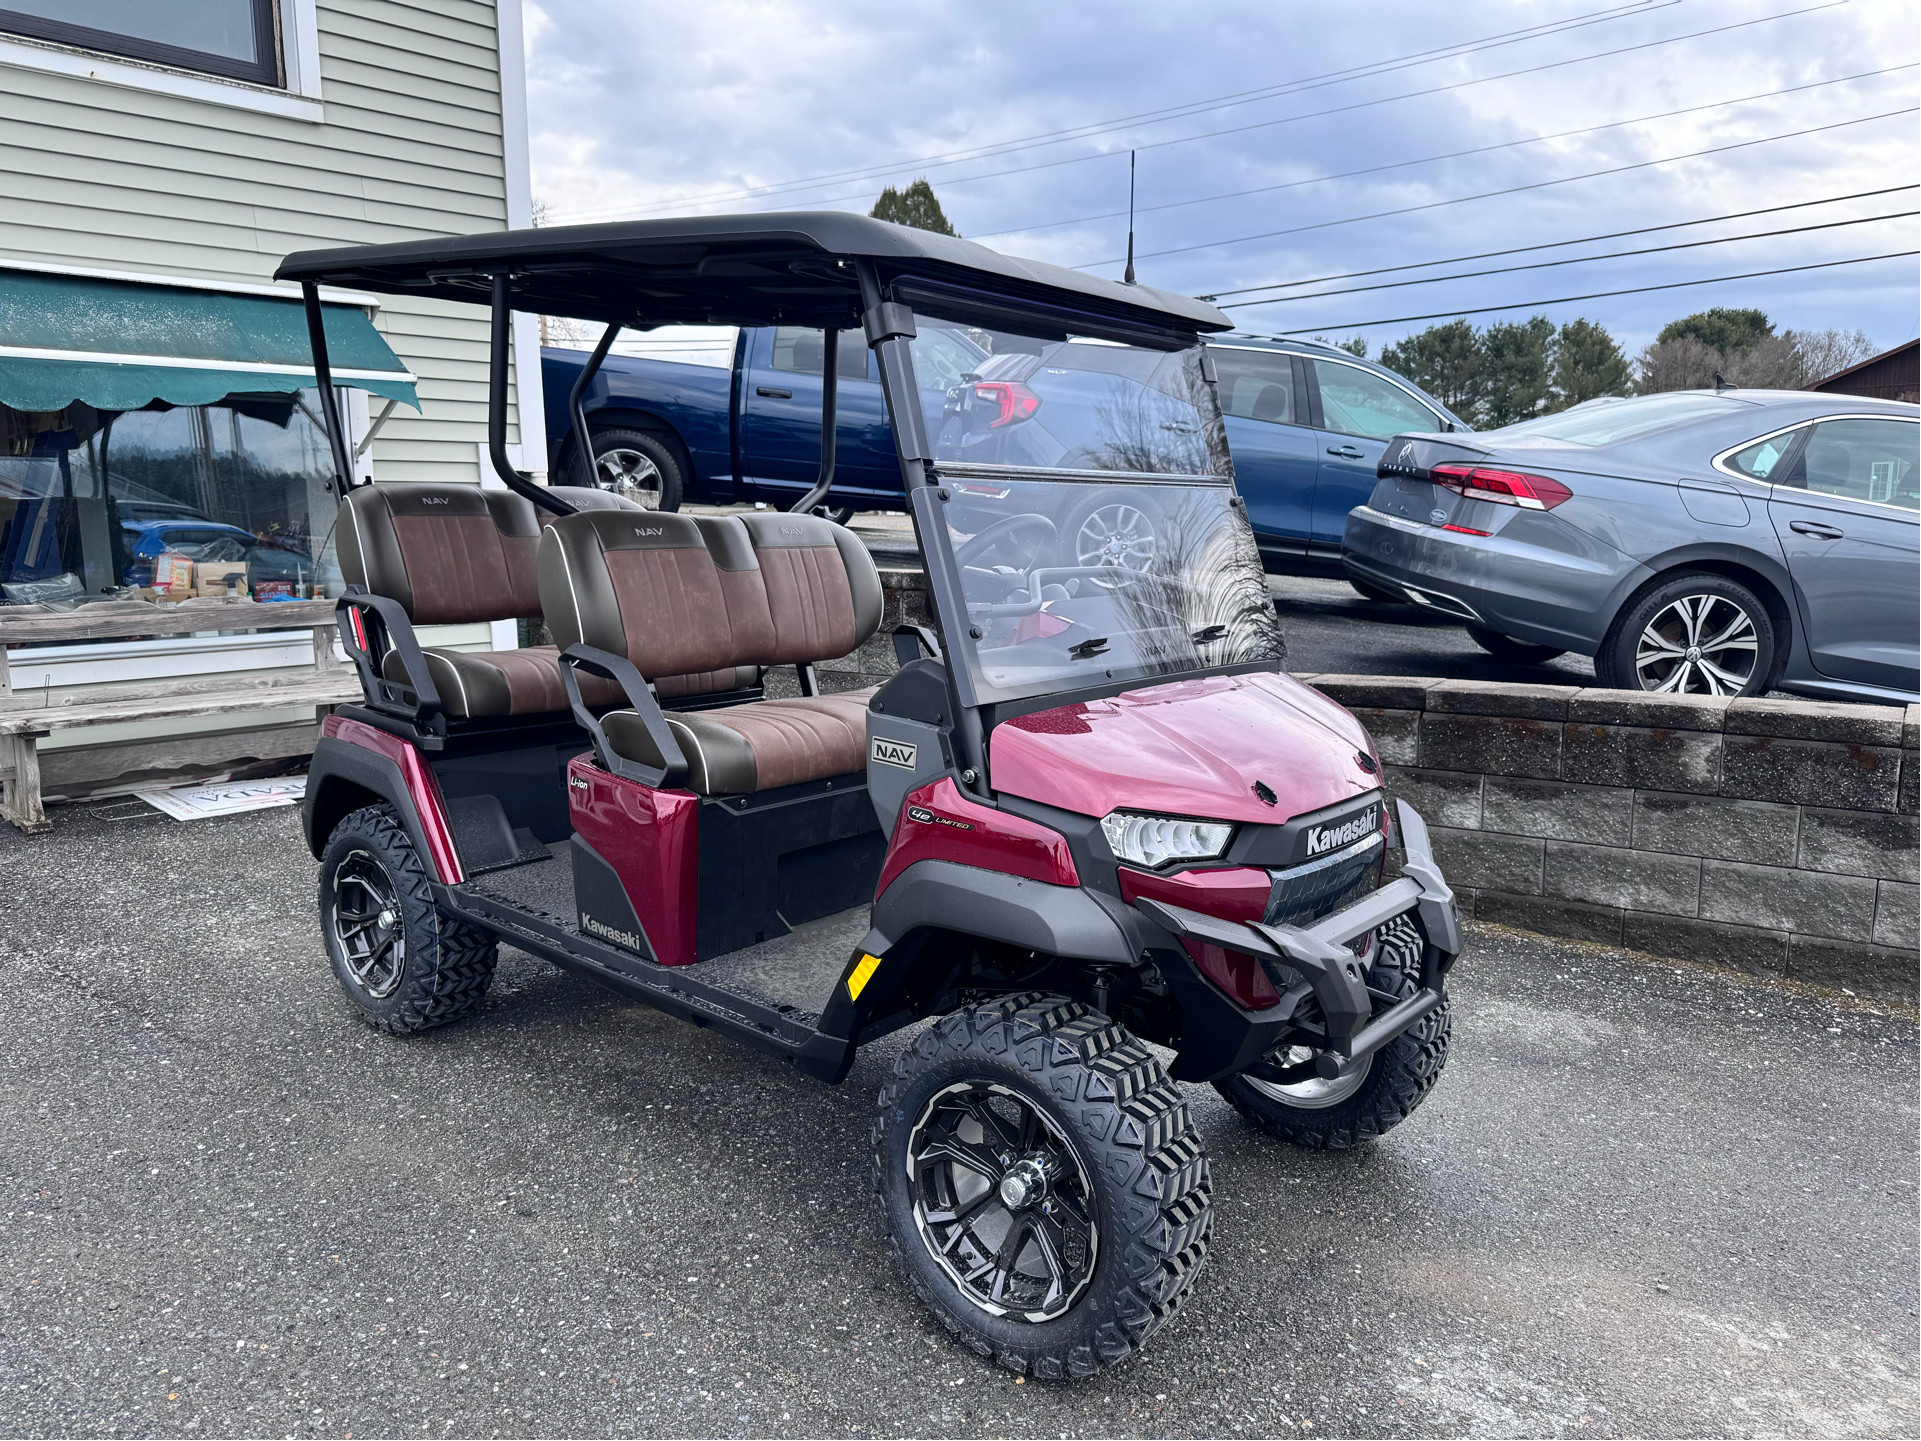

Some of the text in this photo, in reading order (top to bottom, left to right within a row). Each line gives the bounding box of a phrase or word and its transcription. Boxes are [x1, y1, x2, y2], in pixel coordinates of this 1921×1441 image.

[421, 497, 450, 505] NAV
[634, 527, 664, 537] NAV
[780, 527, 805, 536] NAV
[1144, 645, 1166, 657] NAV
[876, 744, 914, 763] NAV
[570, 776, 588, 790] Li-ion
[935, 817, 970, 830] LIMITED
[1306, 804, 1377, 856] Kawasaki
[582, 912, 640, 951] Kawasaki
